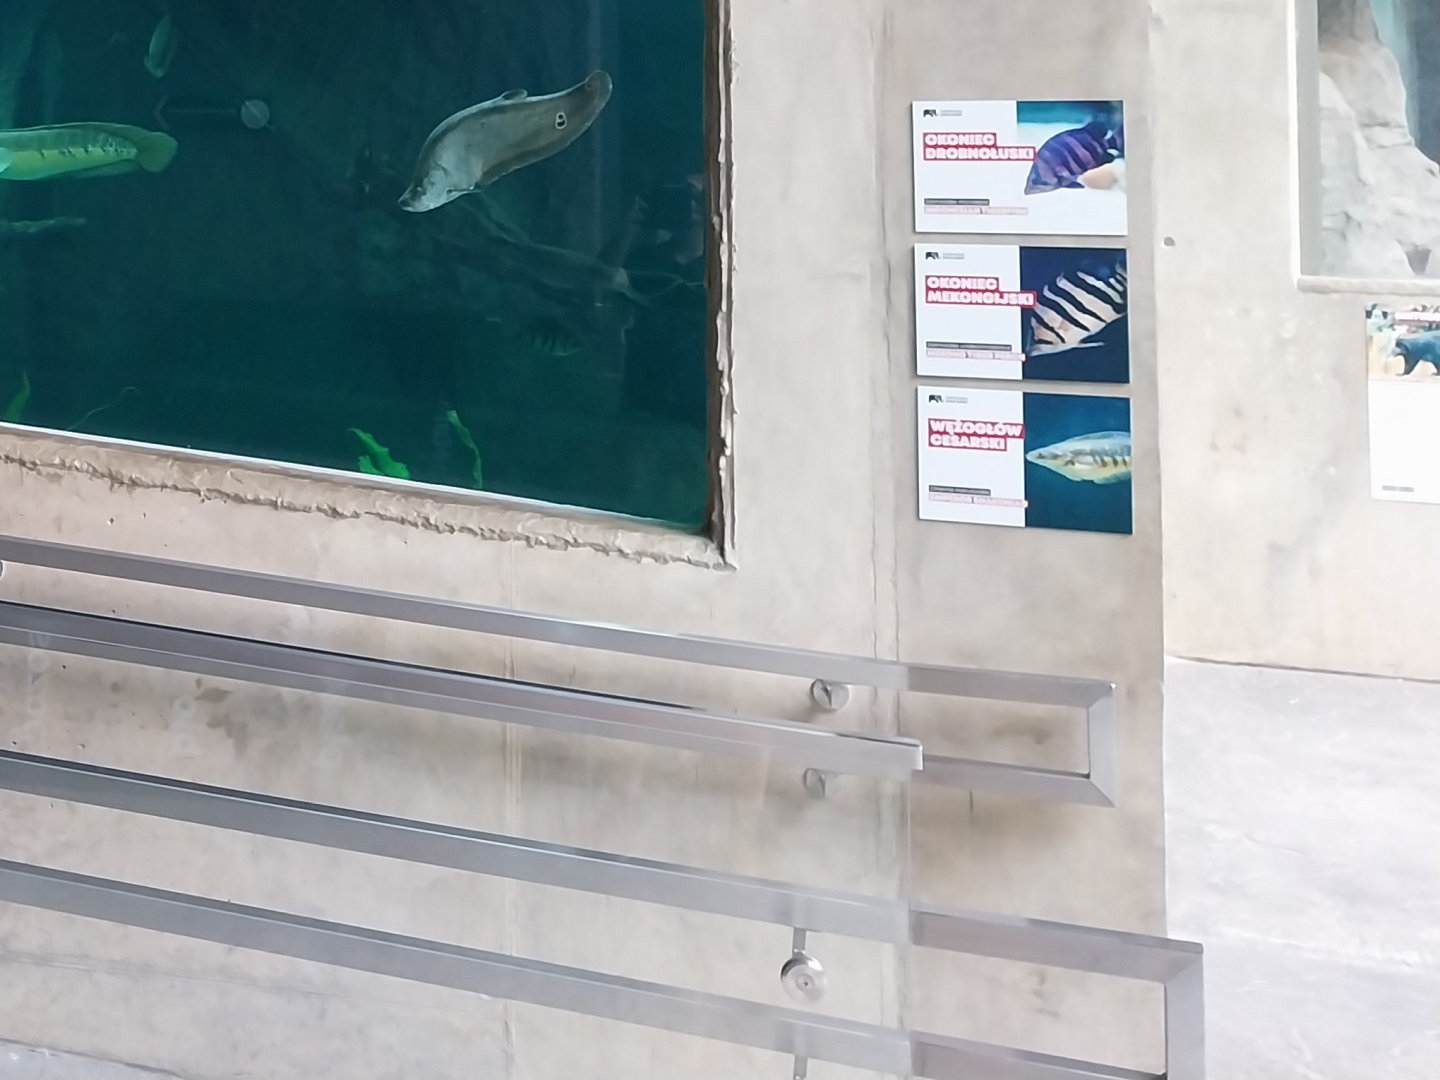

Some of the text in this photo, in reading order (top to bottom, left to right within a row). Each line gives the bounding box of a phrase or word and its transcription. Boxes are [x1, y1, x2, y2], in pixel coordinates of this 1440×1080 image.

[925, 133, 996, 146] OKONIEC
[927, 276, 998, 290] OKONIEC
[930, 436, 1006, 450] CESARSKI
